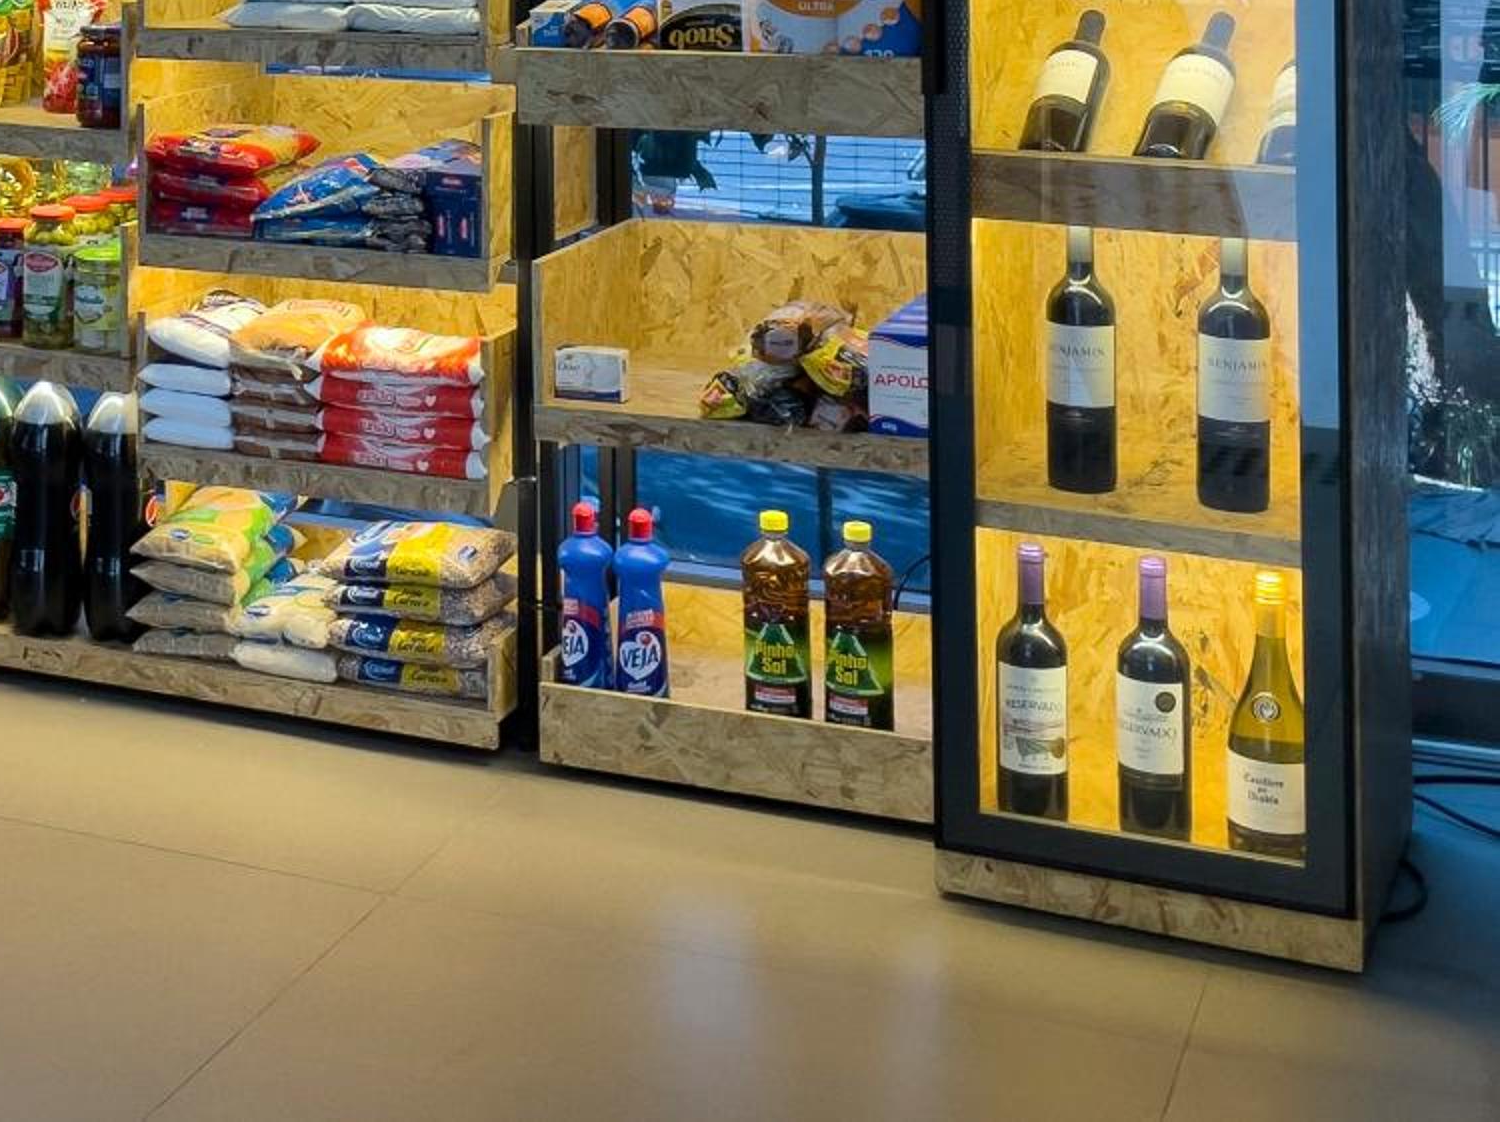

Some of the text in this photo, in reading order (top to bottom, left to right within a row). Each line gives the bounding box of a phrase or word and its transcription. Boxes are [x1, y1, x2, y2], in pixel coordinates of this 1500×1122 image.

[669, 25, 735, 50] Snob
[1053, 345, 1106, 359] NJAMIN
[563, 635, 585, 656] EJA
[756, 641, 795, 659] Pinho
[621, 644, 659, 670] VEJA
[762, 657, 787, 675] Sol
[829, 648, 868, 670] Pinho
[835, 667, 858, 686] Sol
